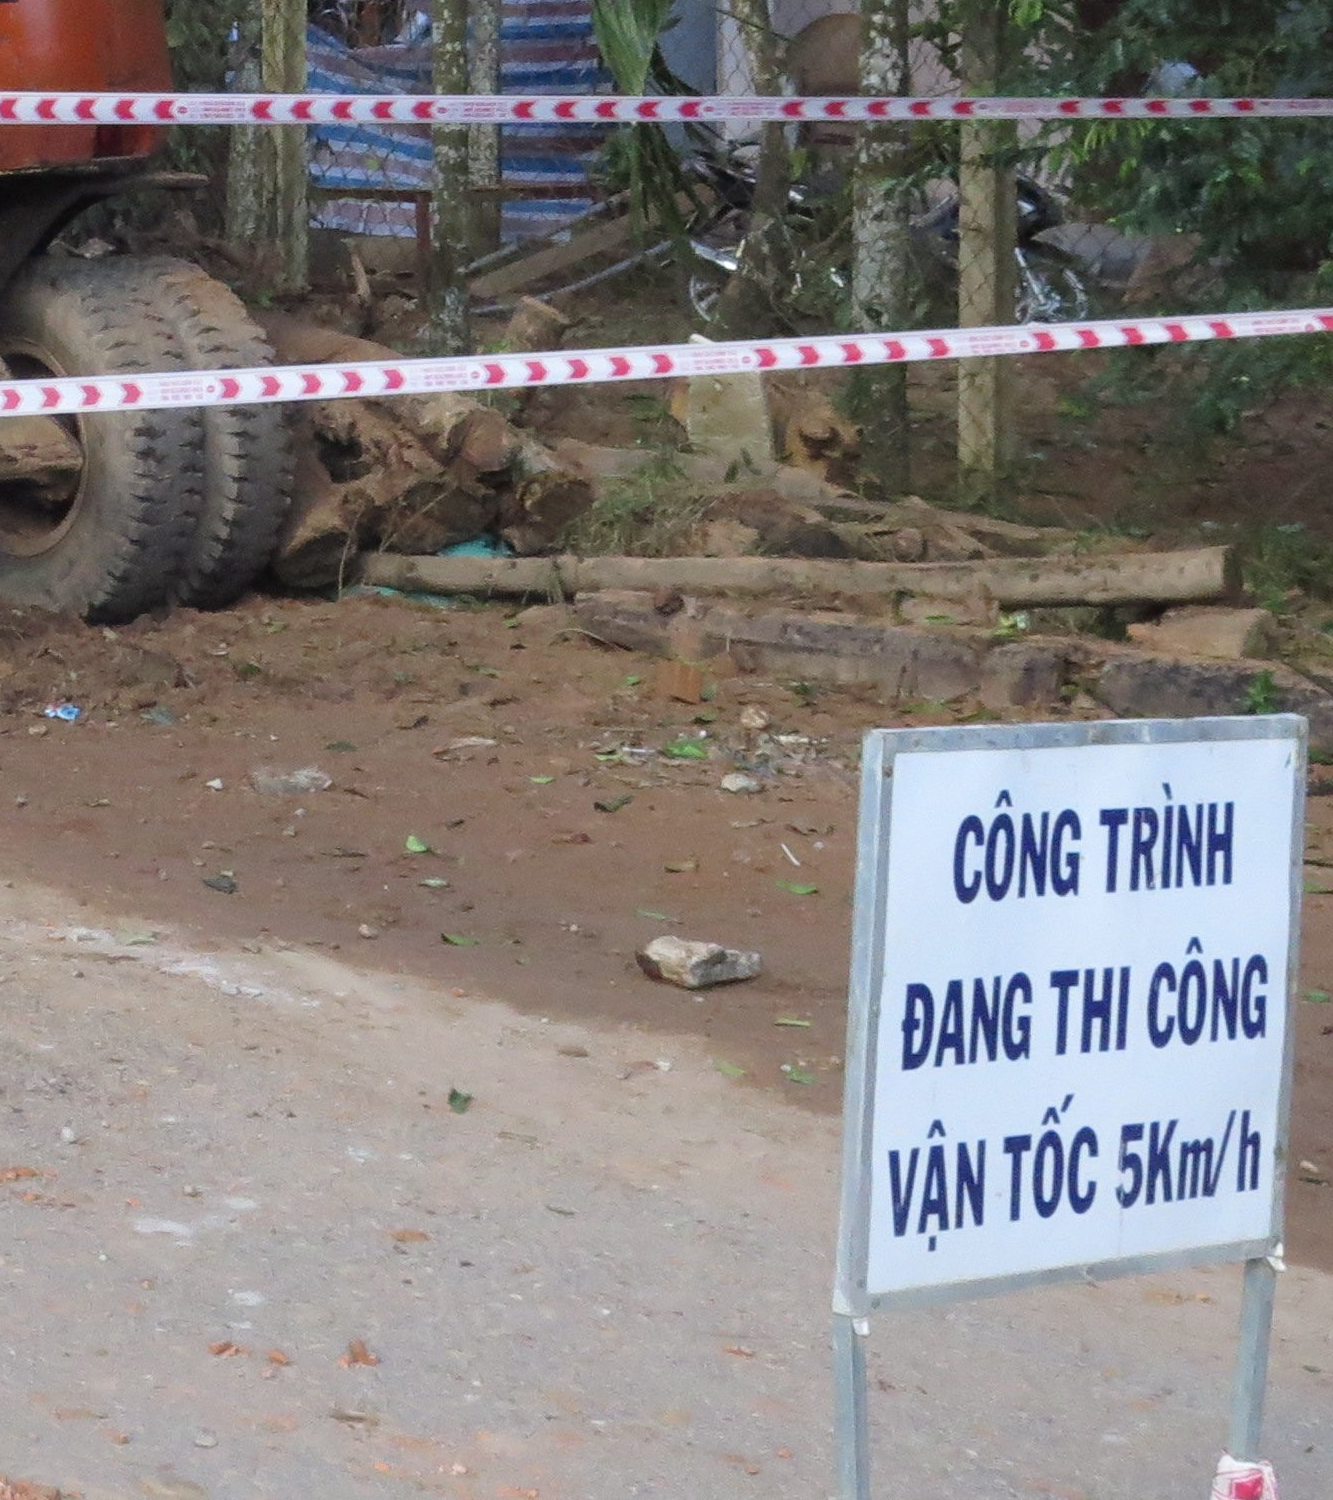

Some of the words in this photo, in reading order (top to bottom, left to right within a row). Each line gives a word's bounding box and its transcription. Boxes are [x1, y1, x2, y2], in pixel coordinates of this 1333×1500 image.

[952, 788, 1083, 905] CÔNG
[1099, 782, 1235, 894] TRÌNH
[900, 971, 1033, 1072] ĐANG
[1050, 966, 1132, 1056] THI
[1147, 936, 1270, 1050] CÔNG
[887, 1118, 987, 1253] VẬN
[1002, 1093, 1100, 1223] TỐC
[1114, 1108, 1263, 1210] 5Km/h
